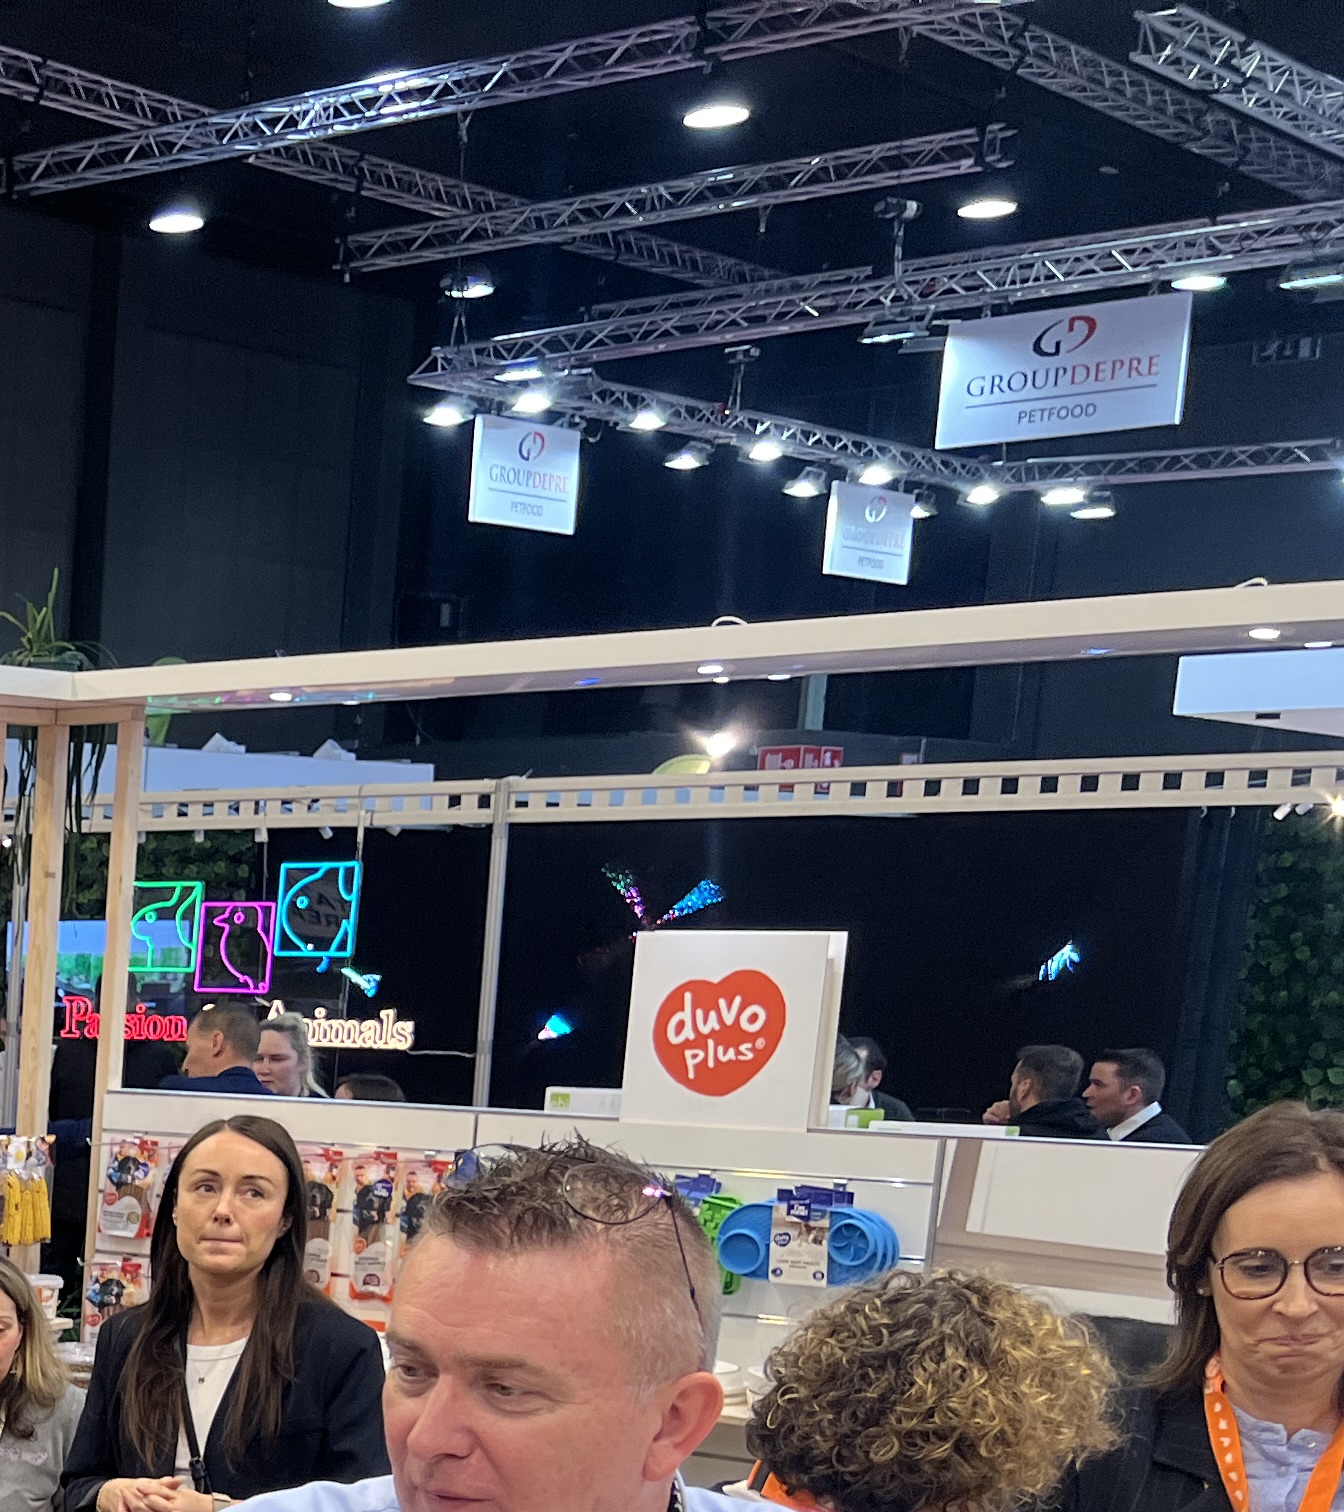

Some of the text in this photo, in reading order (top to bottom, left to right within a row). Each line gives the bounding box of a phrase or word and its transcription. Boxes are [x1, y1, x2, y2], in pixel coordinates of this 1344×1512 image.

[966, 354, 1161, 397] GROUPDEPRE
[1018, 403, 1098, 425] PETFOOD
[489, 464, 569, 494] GROUPDEPRE
[60, 996, 188, 1041] Pasion
[666, 992, 767, 1045] duvo
